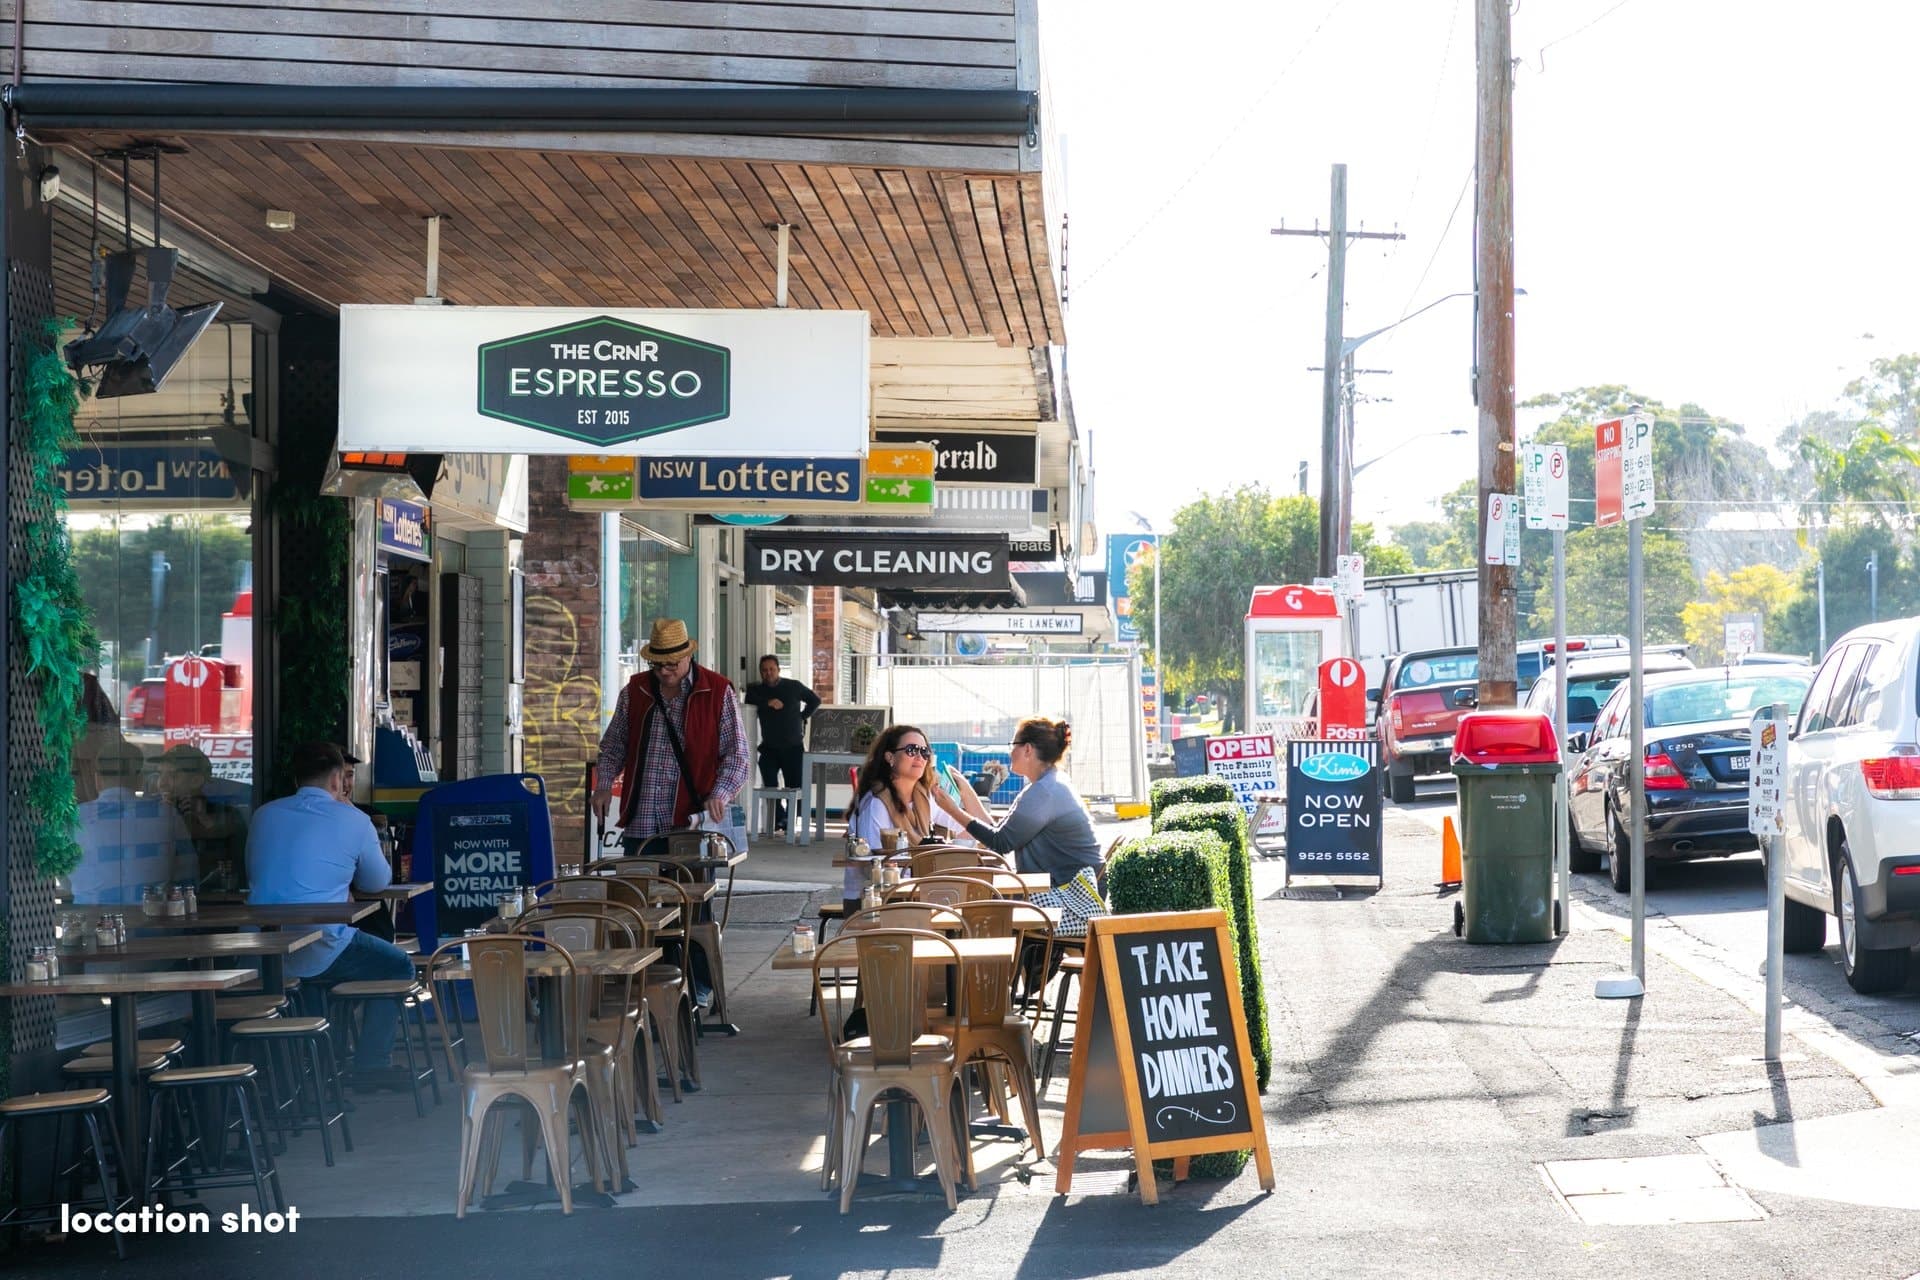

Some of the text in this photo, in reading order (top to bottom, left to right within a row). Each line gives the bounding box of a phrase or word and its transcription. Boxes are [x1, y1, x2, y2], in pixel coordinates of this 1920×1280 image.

[551, 343, 590, 360] THE
[509, 368, 702, 398] ESPRESSO
[577, 410, 630, 425] EST 2015
[1603, 427, 1615, 445] NO
[649, 461, 850, 493] NSW Lotteries
[393, 507, 423, 548] Lotteries
[760, 549, 993, 574] DRY CLEANING
[1008, 618, 1074, 628] THE LANEWAY
[1326, 727, 1366, 739] POST
[1208, 738, 1272, 758] OPEN
[1236, 760, 1272, 771] Family
[1309, 755, 1364, 775] Kim's
[1305, 795, 1364, 809] NOW
[1299, 814, 1370, 828] OPEN
[454, 839, 509, 849] NOW WITH
[444, 851, 522, 874] MORE
[1298, 852, 1370, 860] 9525 5552
[444, 876, 519, 892] OVERALL
[443, 893, 512, 908] WINNE
[1131, 941, 1208, 986] TAKE
[1140, 992, 1218, 1041] HOME
[1141, 1045, 1234, 1098] DINNERS
